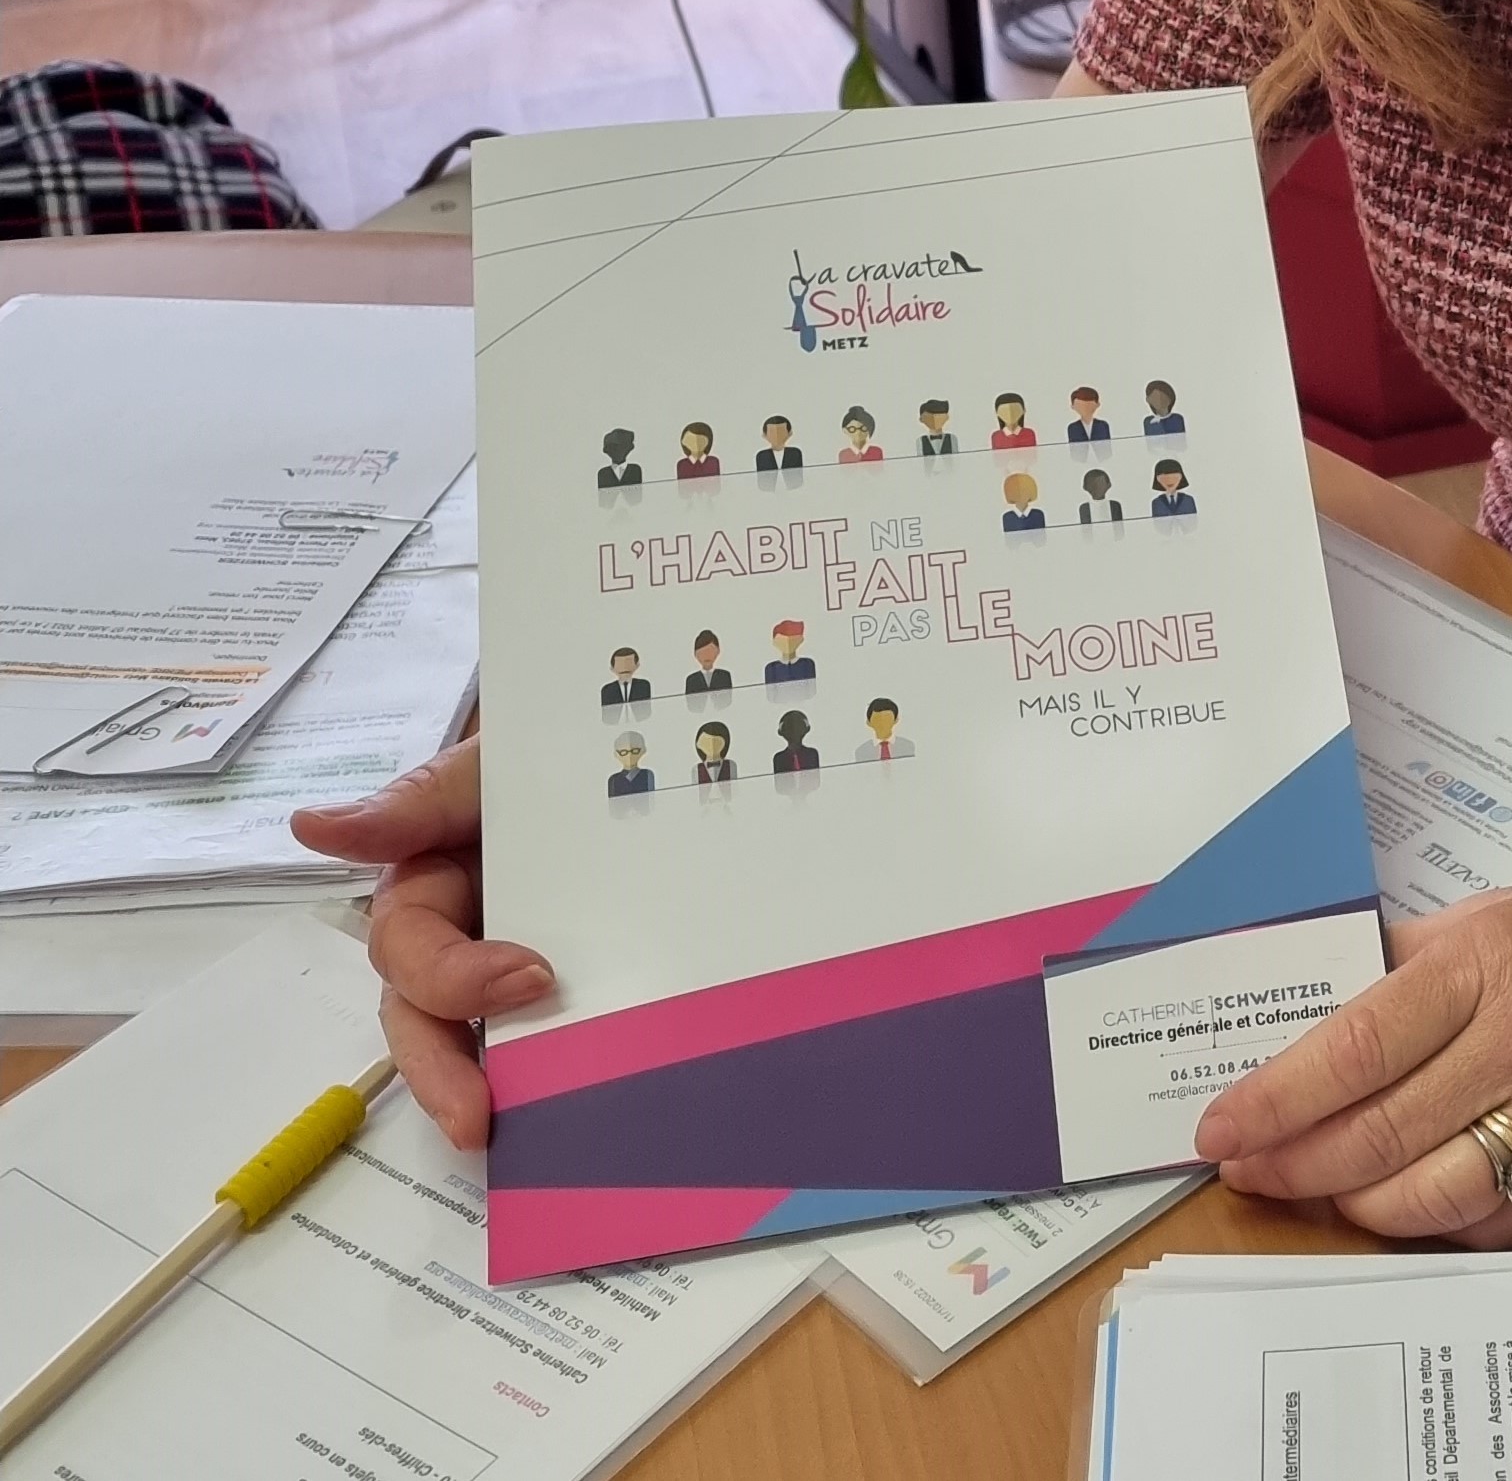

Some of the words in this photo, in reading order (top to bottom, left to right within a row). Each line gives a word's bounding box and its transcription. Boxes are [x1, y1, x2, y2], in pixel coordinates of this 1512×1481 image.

[846, 253, 950, 283] cravate
[807, 283, 952, 333] Solidaire
[822, 336, 868, 351] METZ
[599, 517, 848, 593] L'HABIT
[870, 516, 923, 551] NE
[824, 550, 967, 611] FAIT
[852, 609, 931, 648] PAS
[943, 589, 1014, 644] LE
[1013, 611, 1218, 682] MOINE
[1018, 692, 1081, 720] MAIS
[1093, 689, 1115, 709] IL
[1126, 685, 1142, 705] Y
[1069, 701, 1227, 738] CONTRIBUE
[1413, 842, 1491, 894] GAZETTE
[1102, 998, 1206, 1028] CATHERINE
[1214, 981, 1333, 1011] SCHWEITZER
[1088, 1027, 1163, 1051] Directrice
[1167, 1018, 1233, 1042] générale
[1236, 1014, 1251, 1029] et
[1255, 1001, 1343, 1026] Cofondatric
[409, 1175, 486, 1230] (Responsable
[287, 1208, 359, 1259] Cofondatrice
[1009, 1215, 1048, 1252] Fwd:
[354, 1247, 371, 1265] et
[367, 1251, 420, 1293] générale
[414, 1280, 471, 1322] Directrice
[514, 1286, 536, 1307] 29
[530, 1295, 552, 1315] 44
[547, 1303, 568, 1324] 08
[607, 1285, 661, 1325] Mathilde
[647, 1282, 678, 1308] Mail
[468, 1309, 533, 1355] Schweitzer,
[563, 1312, 585, 1333] 52
[580, 1322, 601, 1342] 06
[575, 1344, 608, 1372] Mail
[600, 1333, 624, 1356] Tél
[1417, 1345, 1433, 1383] retour
[1437, 1345, 1452, 1362] de
[529, 1344, 589, 1388] Catherine
[1479, 1340, 1505, 1425] Associations
[489, 1374, 553, 1422] Contacts
[1418, 1387, 1433, 1403] de
[1437, 1367, 1460, 1465] Départemental
[292, 1428, 332, 1461] cours
[353, 1422, 436, 1481] Chiffres-clés
[1419, 1407, 1437, 1475] conditions
[1488, 1433, 1505, 1460] des
